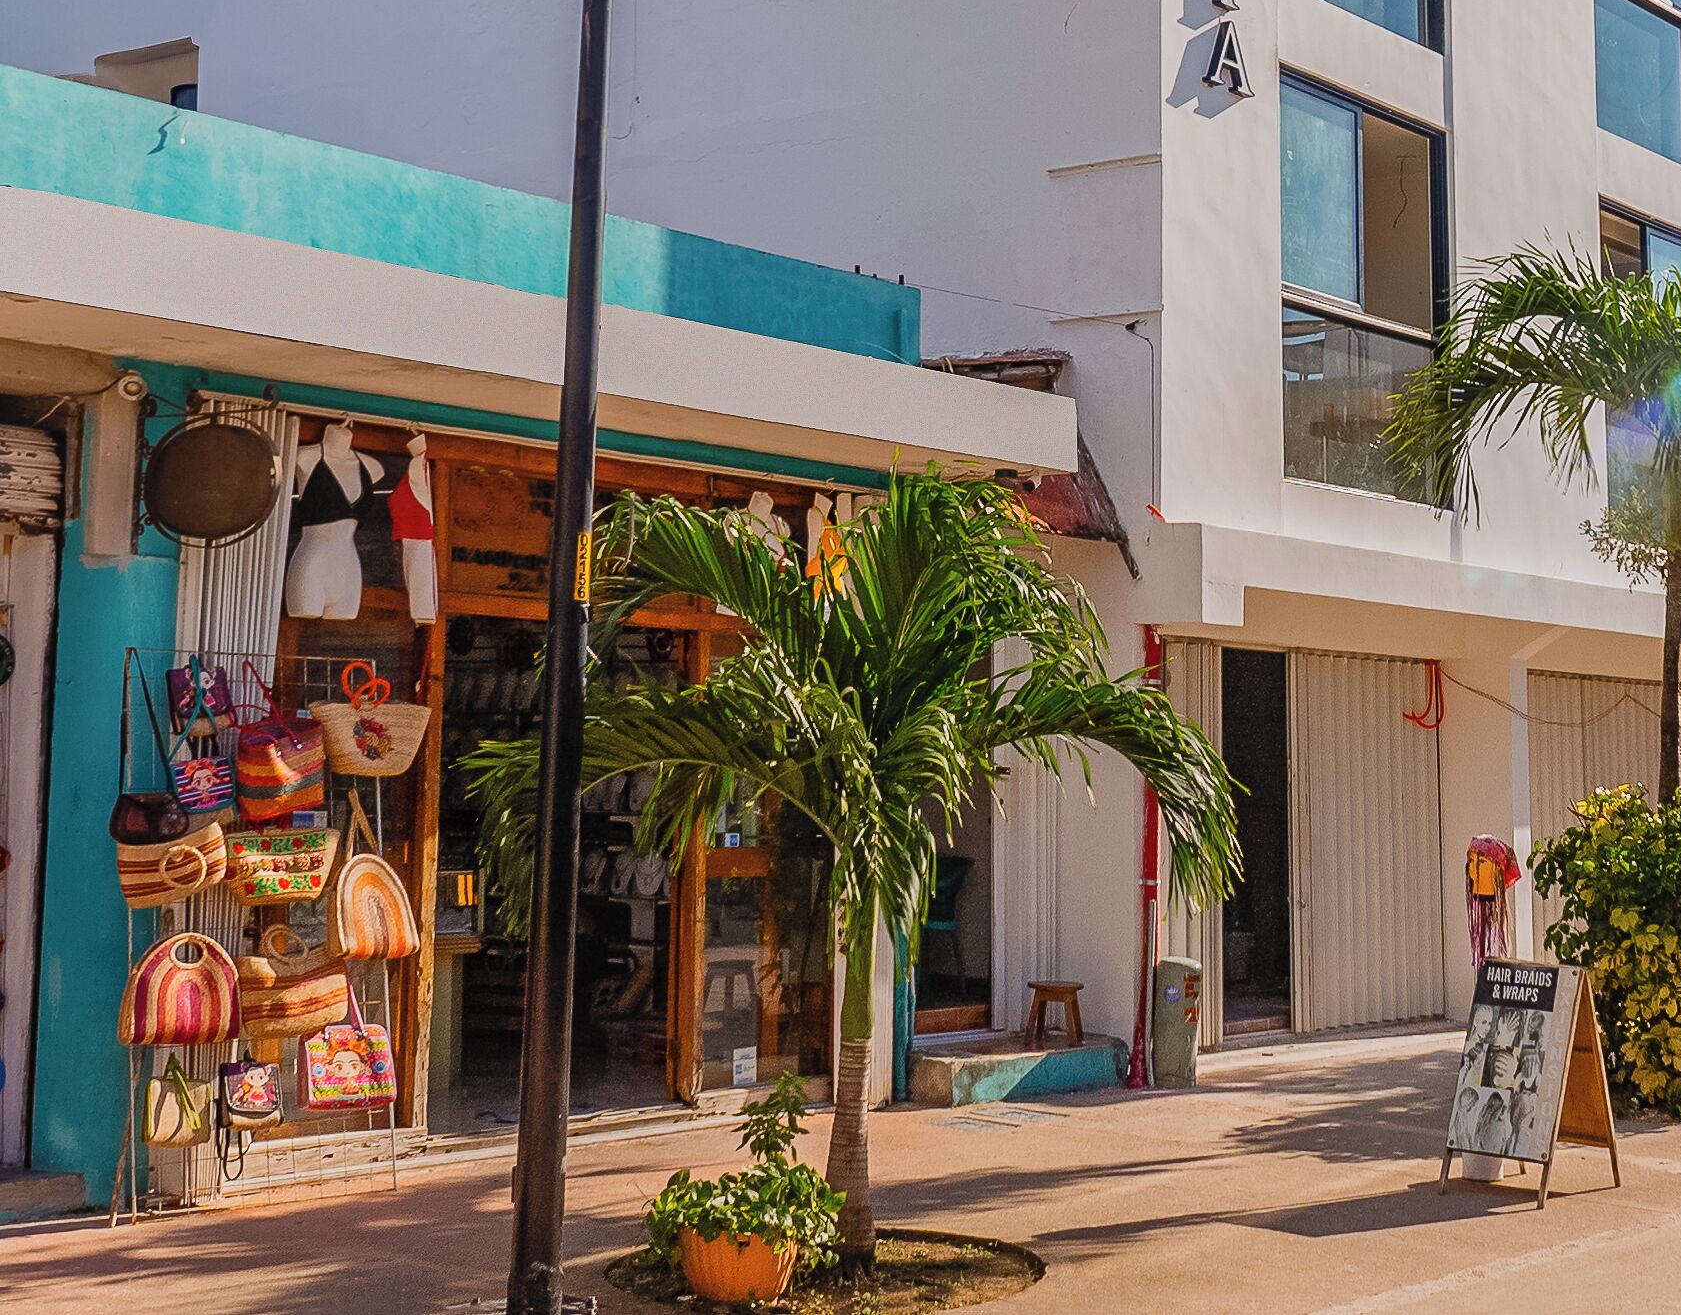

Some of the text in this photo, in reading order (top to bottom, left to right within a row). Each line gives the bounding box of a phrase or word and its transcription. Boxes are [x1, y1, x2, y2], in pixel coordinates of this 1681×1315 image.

[1486, 966, 1553, 987] HAIR BRAIDS
[1492, 983, 1539, 1003] & WRAPS
